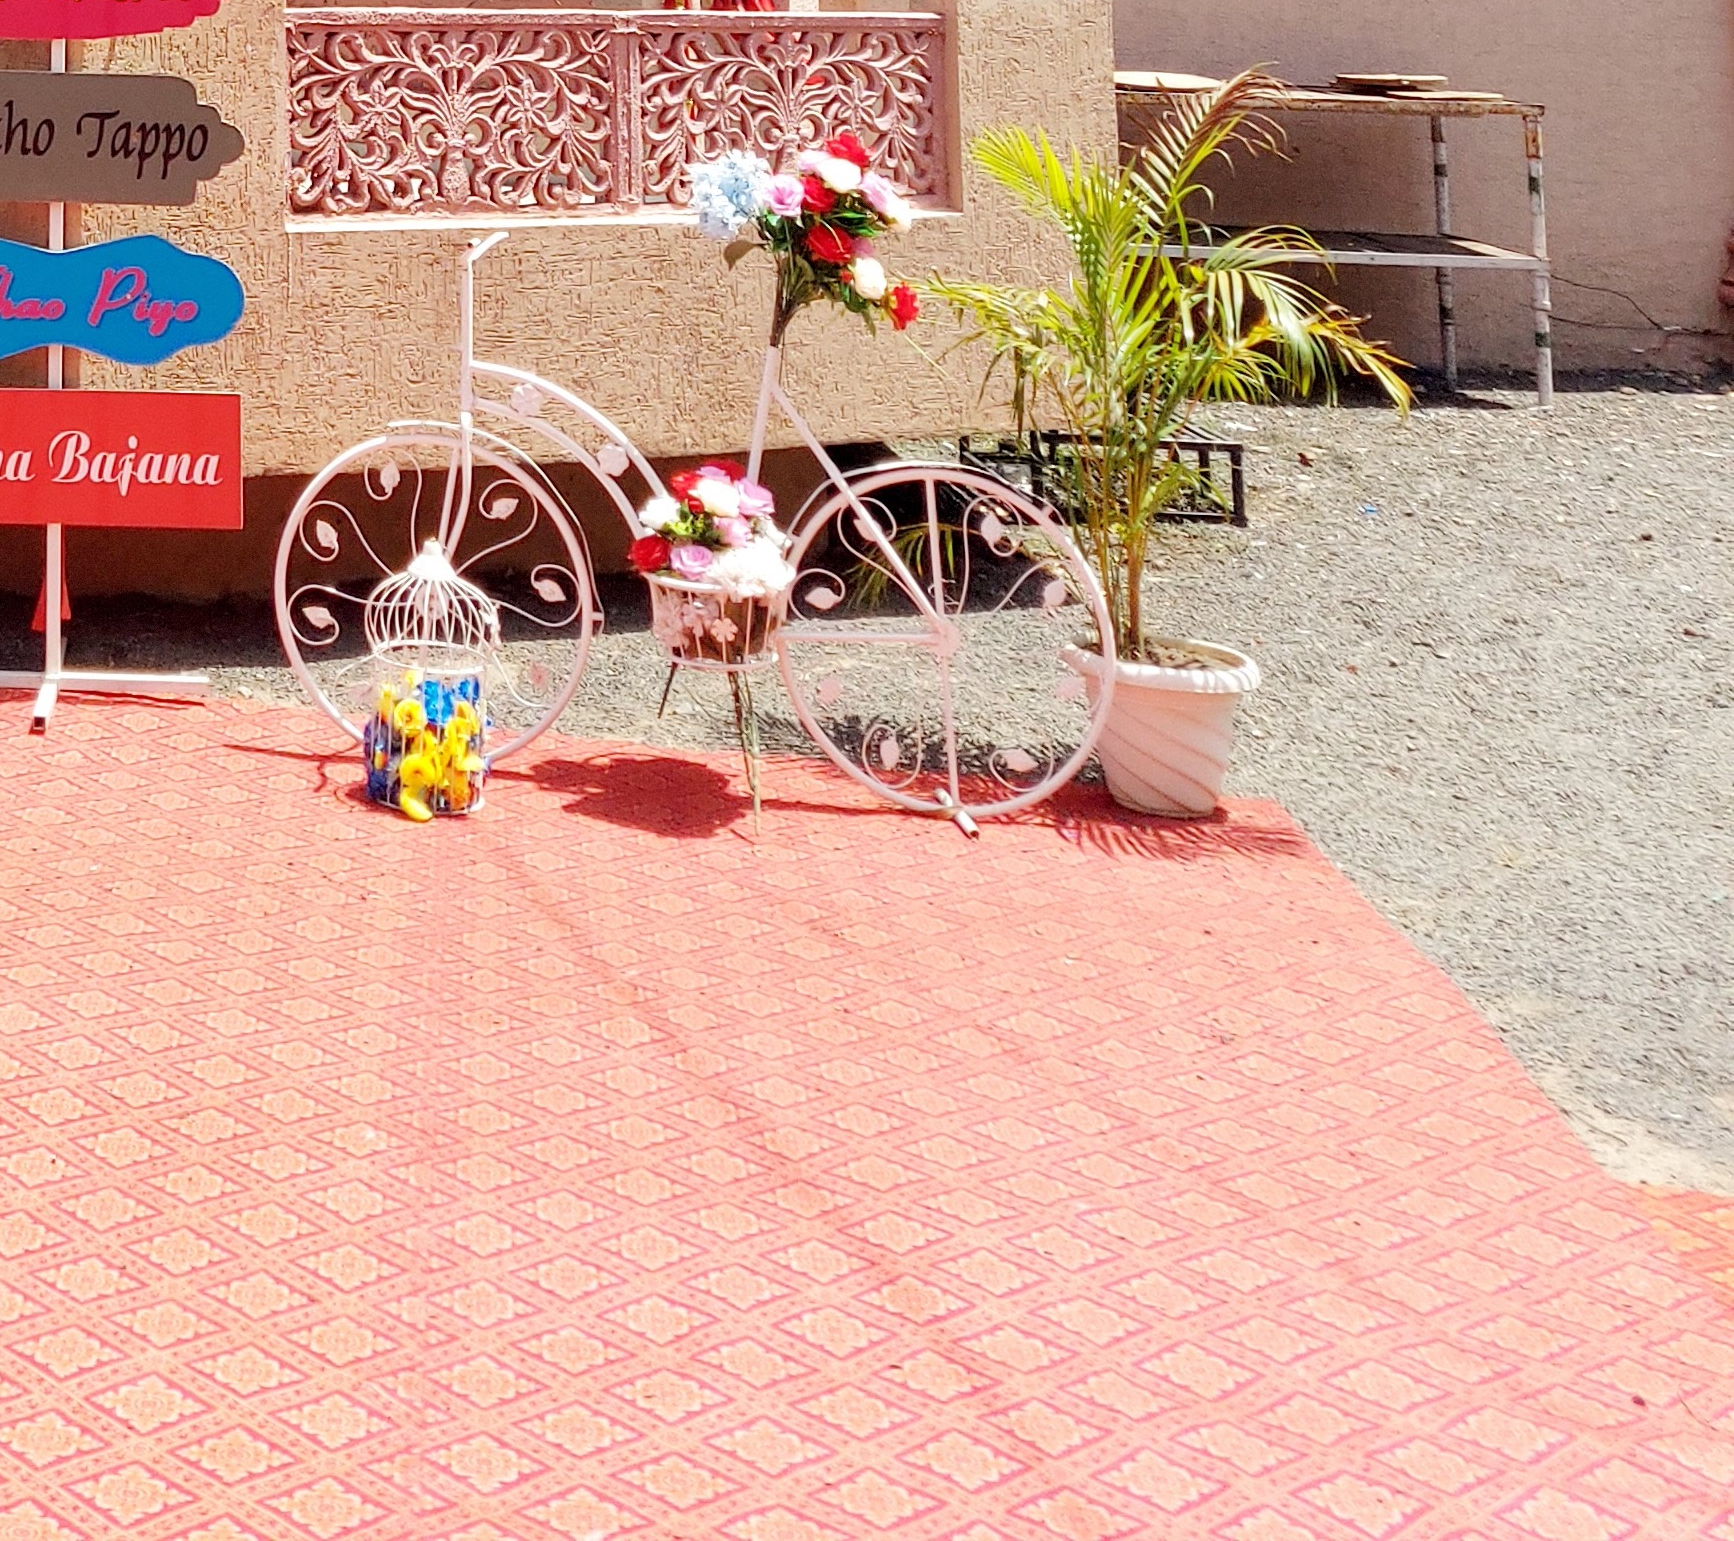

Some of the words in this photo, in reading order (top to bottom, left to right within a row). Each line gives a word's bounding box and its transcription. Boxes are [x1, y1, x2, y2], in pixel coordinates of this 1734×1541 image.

[75, 109, 209, 180] Tappo
[88, 266, 200, 337] Piyo
[47, 429, 223, 497] Bajana
